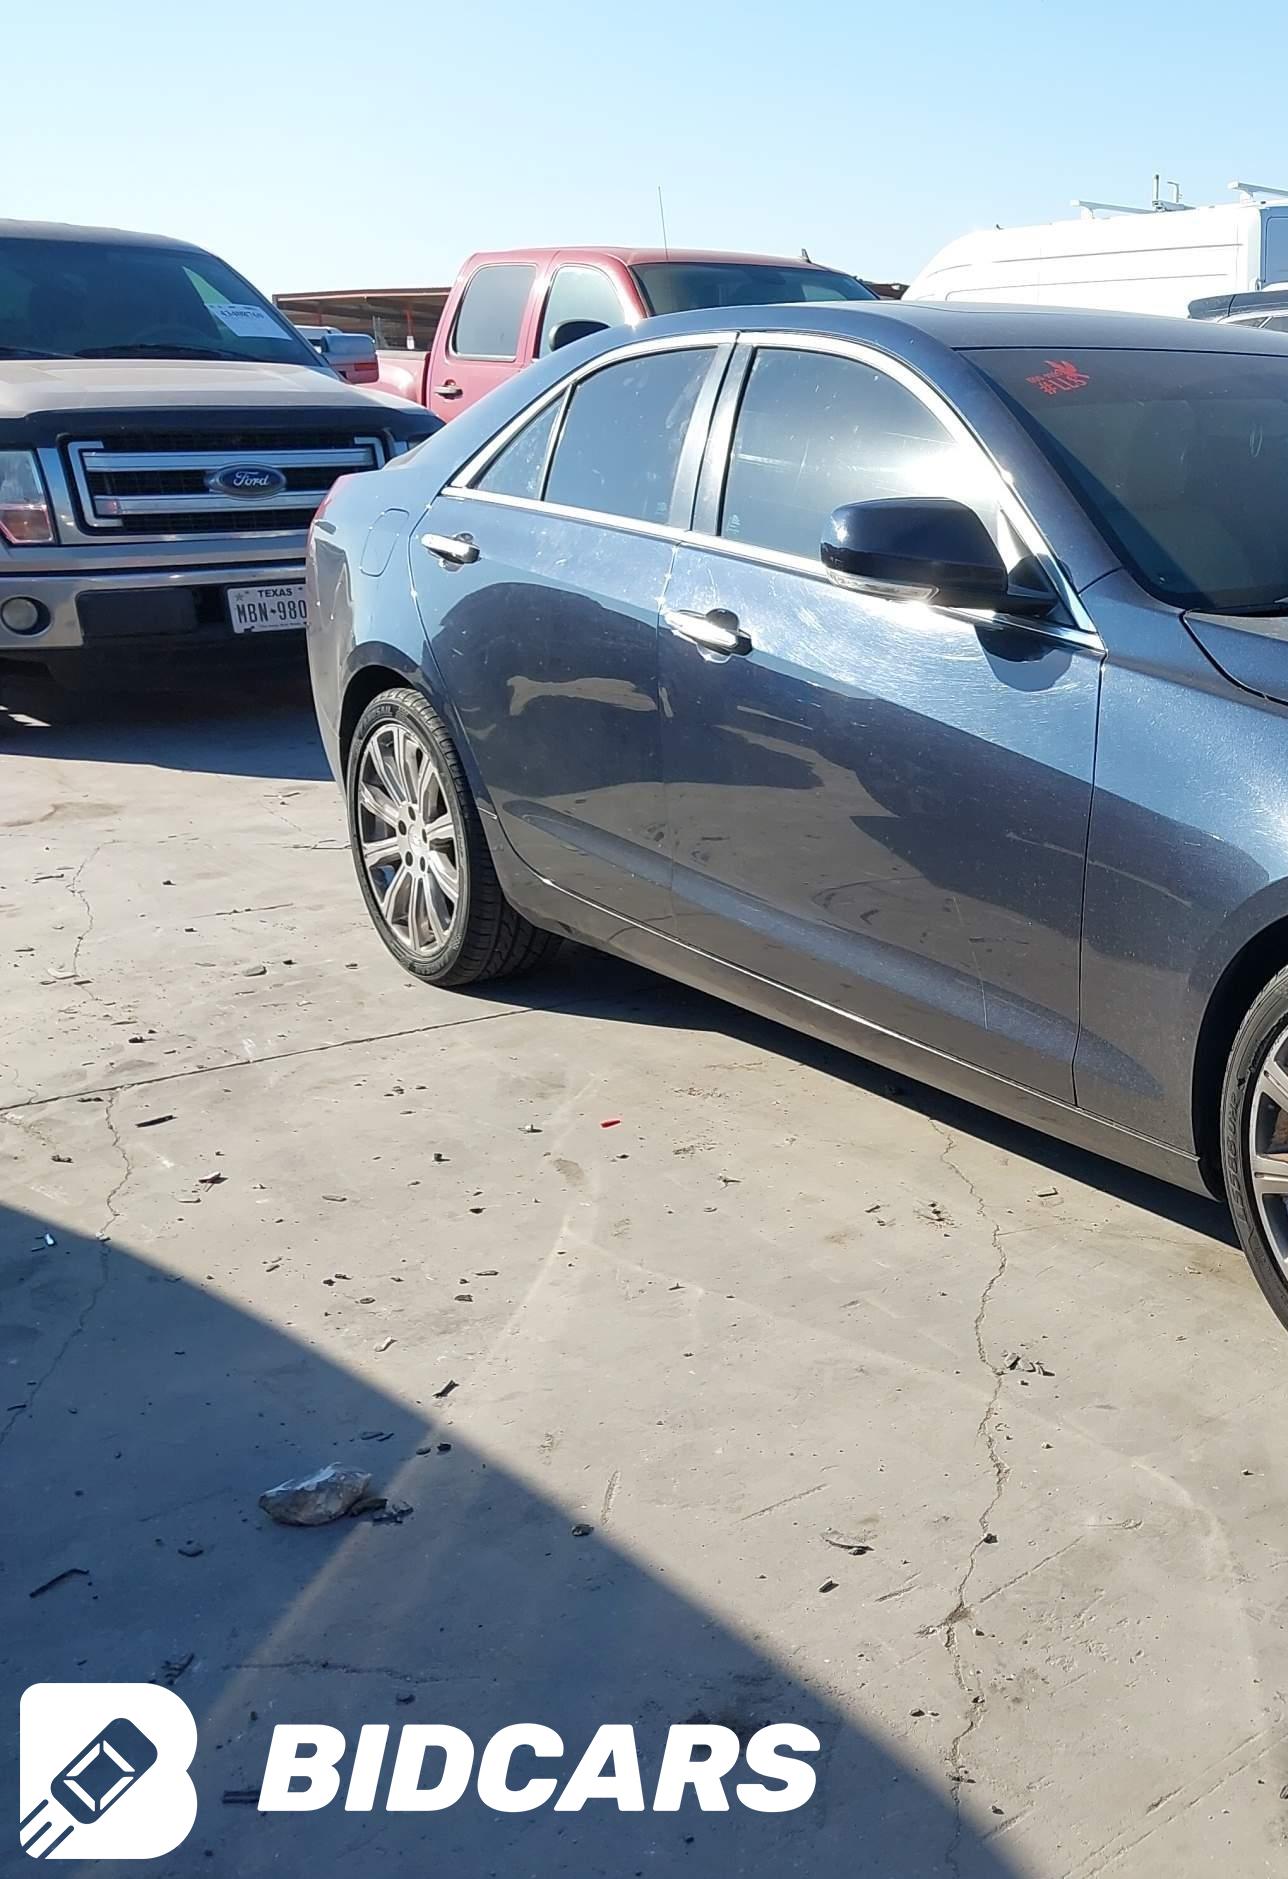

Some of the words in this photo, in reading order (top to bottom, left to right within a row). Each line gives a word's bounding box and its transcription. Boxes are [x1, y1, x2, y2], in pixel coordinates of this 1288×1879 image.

[232, 470, 271, 487] Ford
[257, 587, 293, 598] TEXAS
[236, 599, 308, 624] MBN-980
